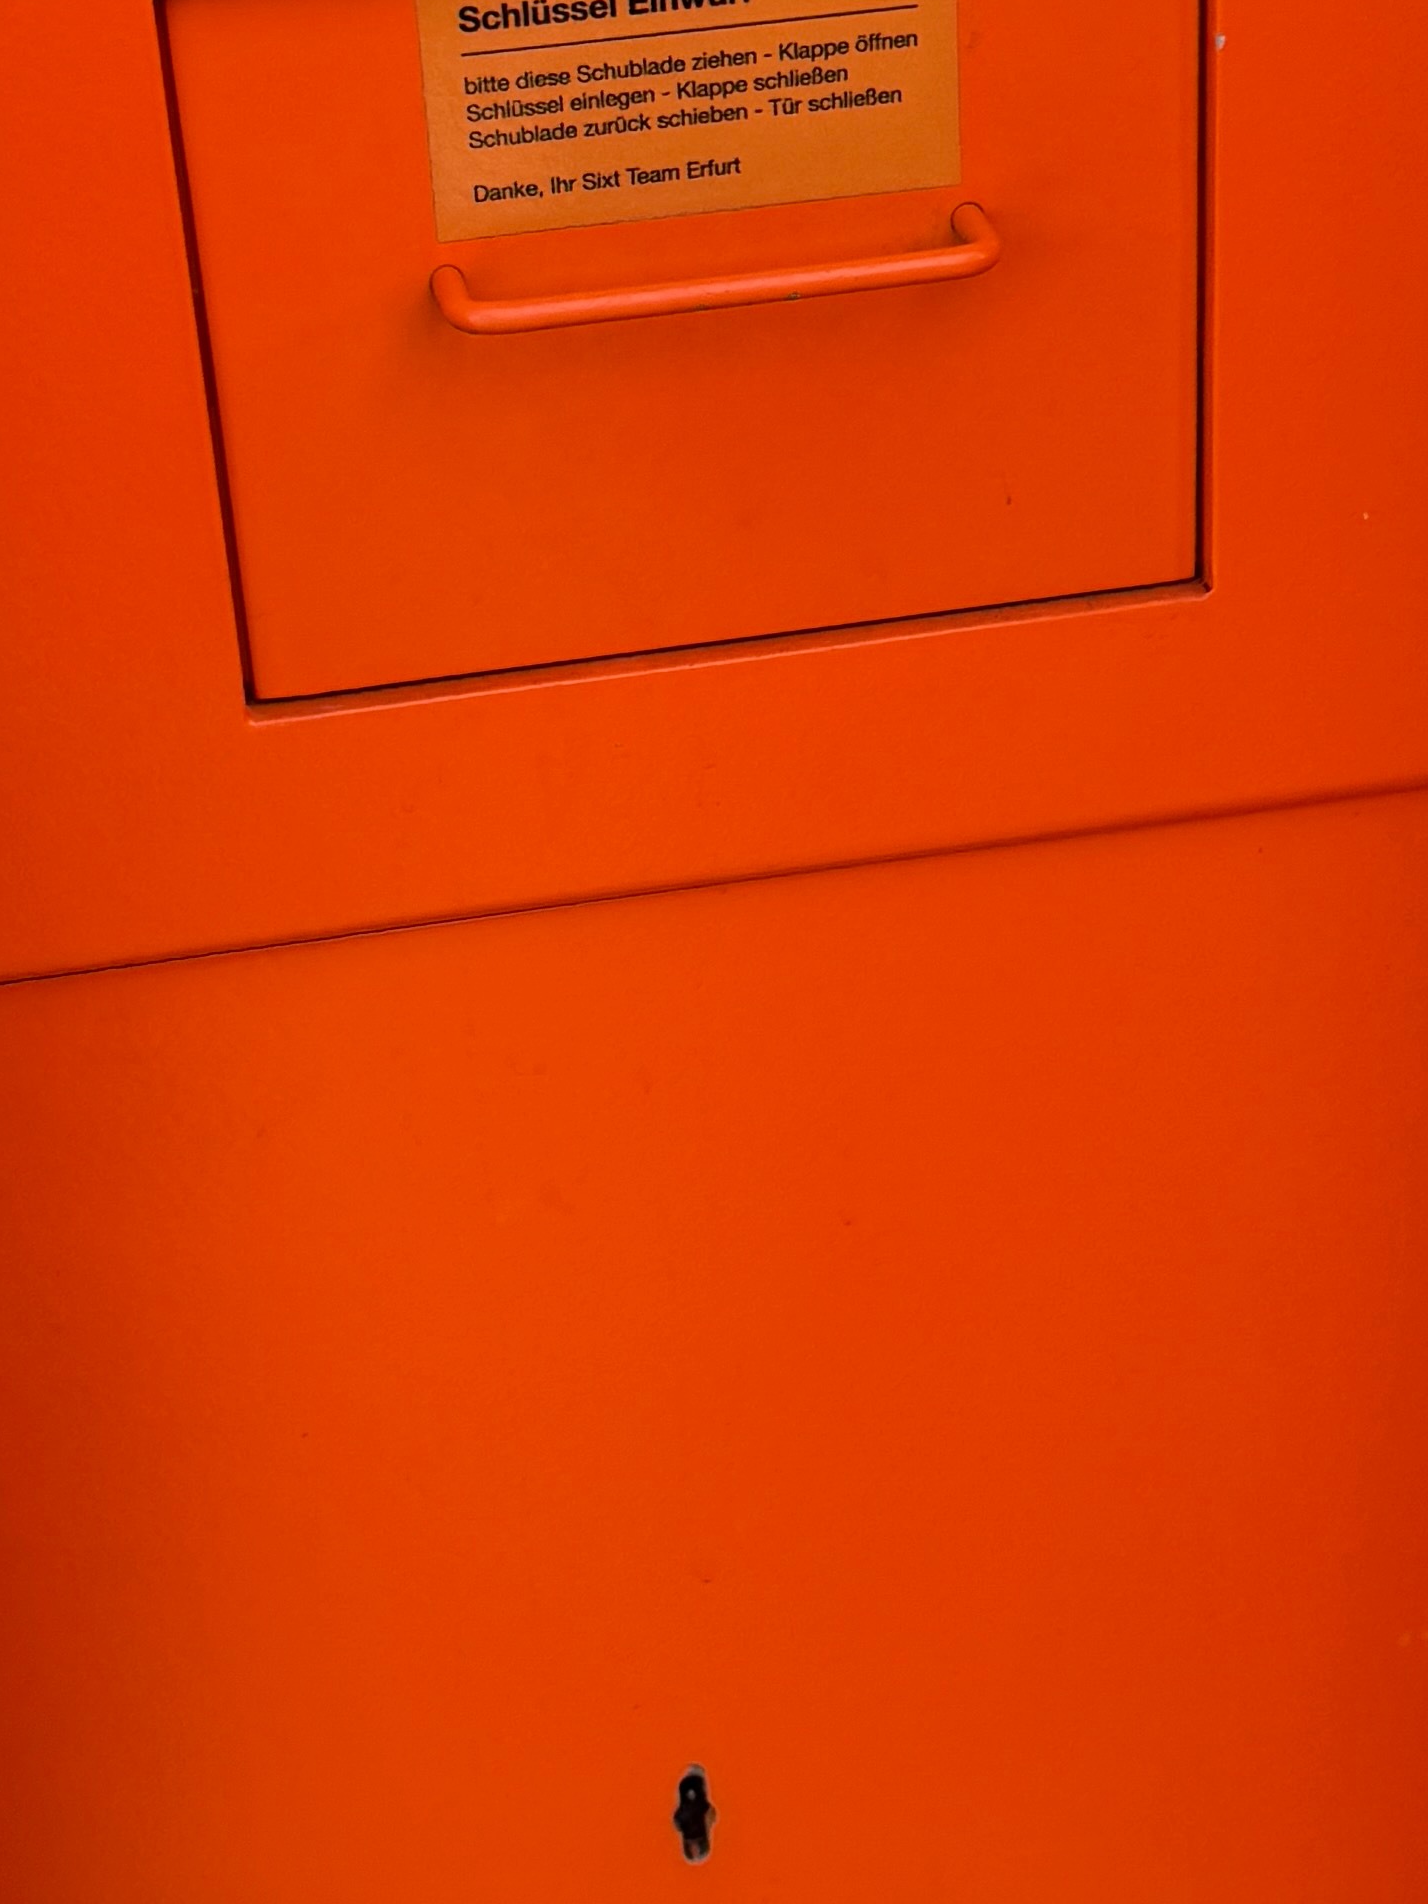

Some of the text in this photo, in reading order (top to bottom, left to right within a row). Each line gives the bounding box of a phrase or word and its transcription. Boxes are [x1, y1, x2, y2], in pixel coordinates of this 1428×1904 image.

[464, 76, 509, 95] bitte
[515, 71, 571, 90] diese
[577, 55, 686, 83] Schublade
[692, 50, 757, 71] ziehen
[779, 41, 849, 63] Klappe
[855, 32, 917, 52] öffnen
[467, 95, 563, 122] Schlüssel
[570, 89, 655, 111] einlegen
[677, 79, 748, 101] Klappe
[753, 66, 848, 91] schließen
[469, 123, 577, 149] Schublade
[584, 113, 651, 137] zurück
[657, 105, 748, 129] schieben
[768, 97, 802, 117] Tür
[808, 87, 901, 113] schließen
[474, 158, 740, 203] Danke, Ihr Sixt Team Erfurt
